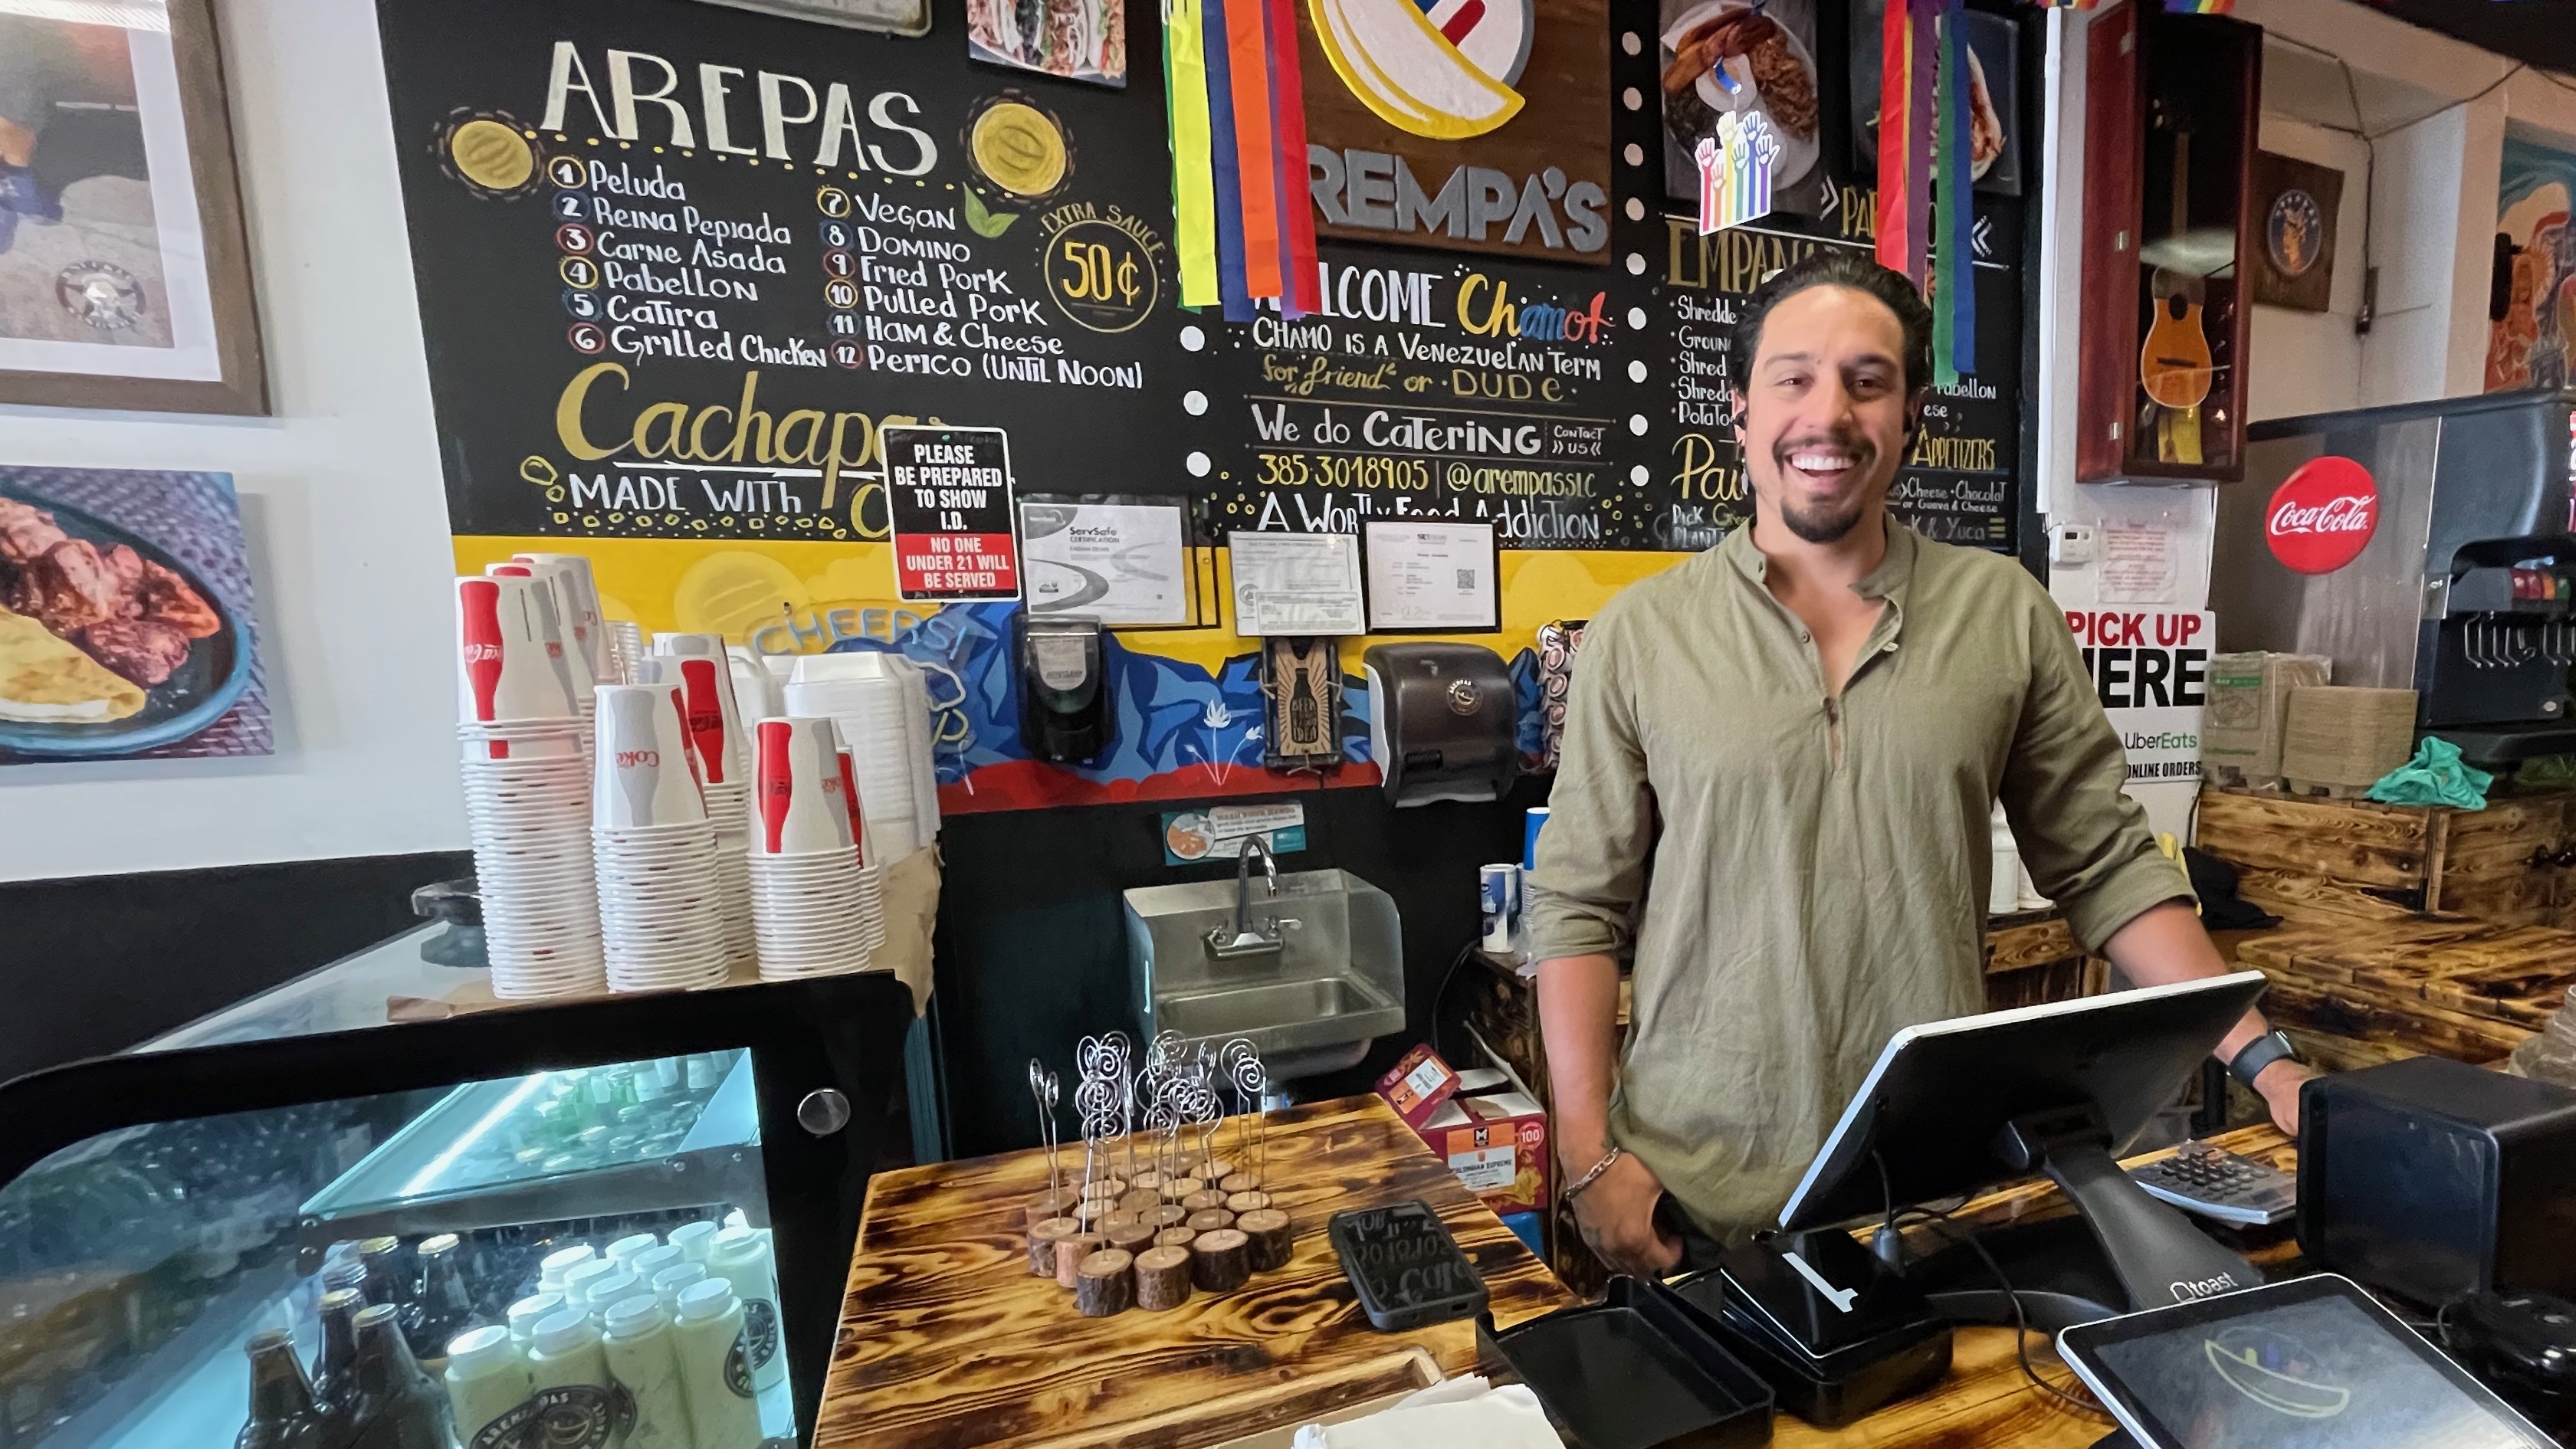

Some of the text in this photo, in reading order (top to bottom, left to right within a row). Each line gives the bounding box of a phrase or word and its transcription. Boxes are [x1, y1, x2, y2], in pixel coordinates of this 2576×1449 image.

[540, 41, 938, 175] AREPAS
[560, 160, 686, 202] 1 Peluda
[563, 198, 580, 216] 2
[828, 194, 841, 214] 7
[1308, 143, 1609, 253] REMPA'S
[829, 225, 845, 246] 8
[1041, 201, 1166, 257] EXTRA SAUCE
[566, 229, 585, 250] 3
[691, 239, 786, 274] Asada
[1665, 220, 1843, 294] EMPAN
[569, 261, 588, 283] 4
[832, 254, 846, 275] 9
[861, 257, 928, 287] Fried
[574, 293, 594, 316] 5
[831, 284, 852, 304] 10
[864, 284, 957, 319] Pulled
[1255, 261, 1446, 327] LCOME
[1678, 295, 1738, 325] Shredde
[575, 328, 596, 349] 6
[611, 325, 733, 367] Grilled
[833, 316, 852, 333] 11
[934, 323, 956, 346] &
[961, 323, 1064, 355] Cheese
[1253, 316, 1332, 351] CHAMO
[1346, 333, 1365, 354] IS
[1374, 335, 1389, 356] A
[836, 346, 856, 364] 12
[1679, 350, 1727, 376] Shred
[1261, 354, 1298, 382] for
[1404, 375, 1434, 392] or
[556, 362, 950, 510] Cachap
[1251, 404, 1300, 441] We
[1314, 414, 1350, 444] do
[914, 444, 975, 465] PLEASE
[569, 474, 685, 510] MADE
[894, 466, 1003, 487] BE PREPARED
[914, 489, 986, 509] TO SHOW
[1258, 491, 1291, 531] A
[2271, 495, 2377, 536] Coca-Cola
[940, 511, 967, 530] I.D.
[1069, 526, 1117, 536] ServSafe
[930, 537, 982, 553] NO ONE
[906, 555, 1009, 571] UNDER 21 WILL
[924, 572, 996, 588] BE SERVED
[754, 608, 966, 661] CHEERS!
[2066, 611, 2201, 647] PICK UP
[2162, 761, 2202, 778] ORDERS
[1521, 1129, 1541, 1143] 100
[2188, 1272, 2238, 1297] toast
